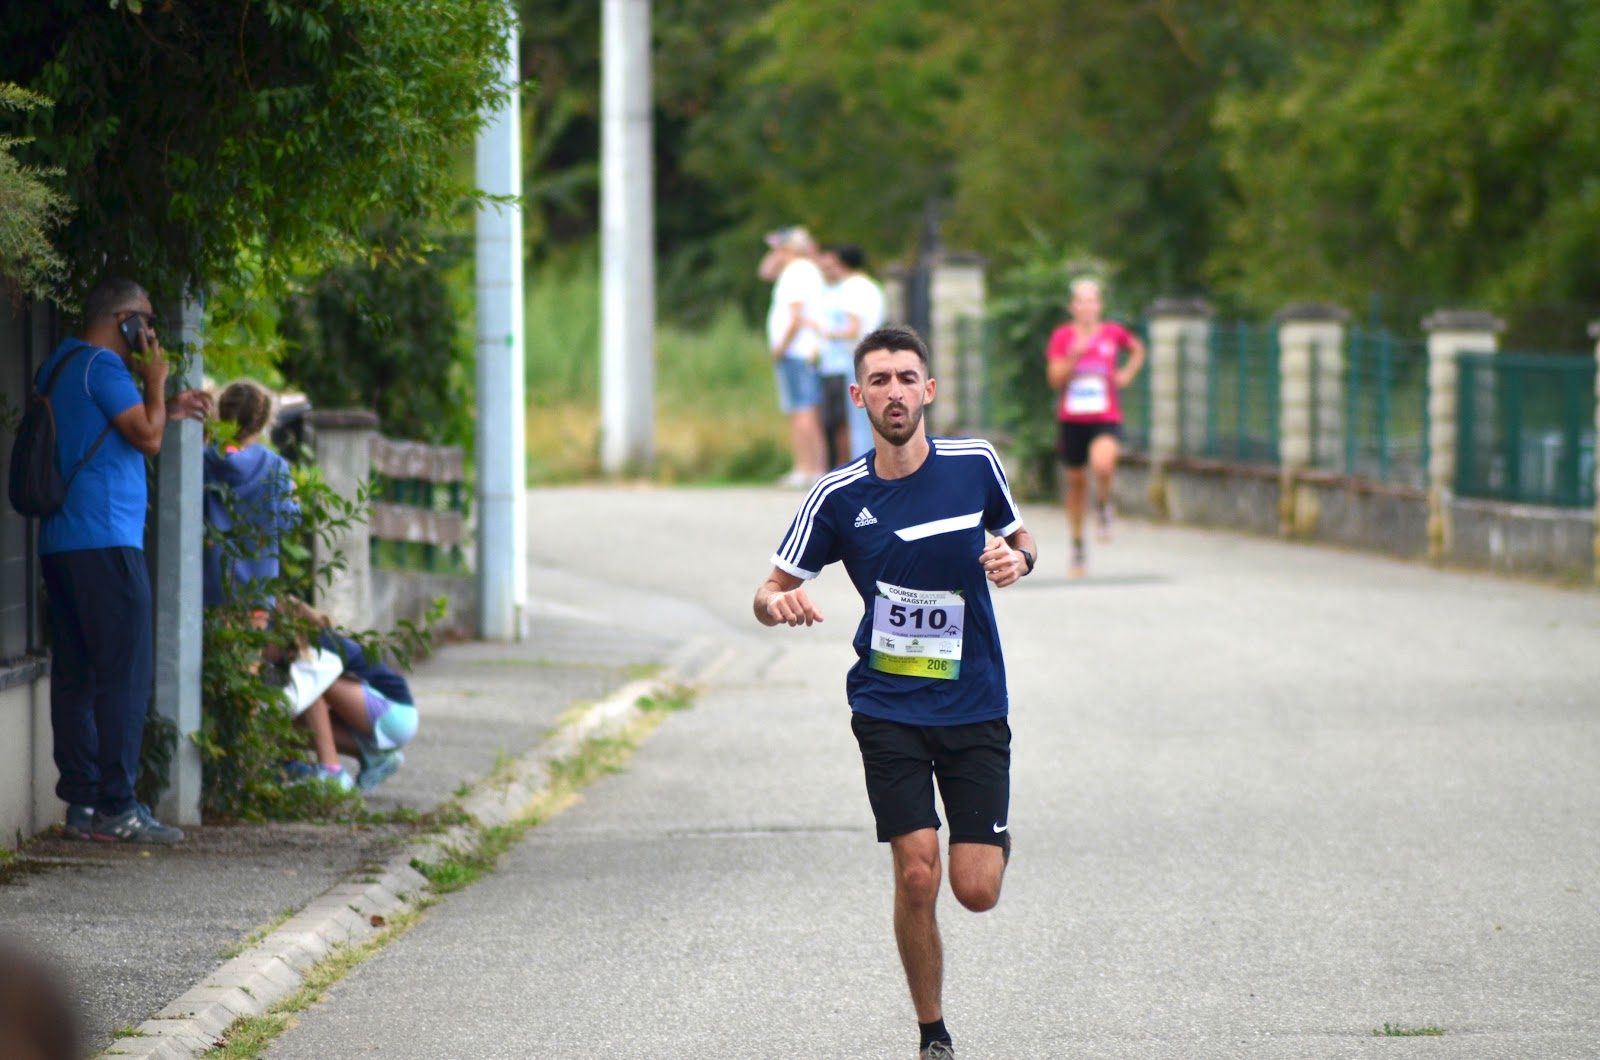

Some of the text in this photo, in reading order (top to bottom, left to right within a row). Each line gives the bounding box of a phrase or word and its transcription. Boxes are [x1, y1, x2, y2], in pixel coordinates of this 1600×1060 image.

[854, 517, 878, 528] adidas
[889, 587, 918, 599] COURSES
[901, 597, 937, 605] MAGSTATT
[888, 604, 948, 630] 510
[927, 659, 948, 671] 20€
